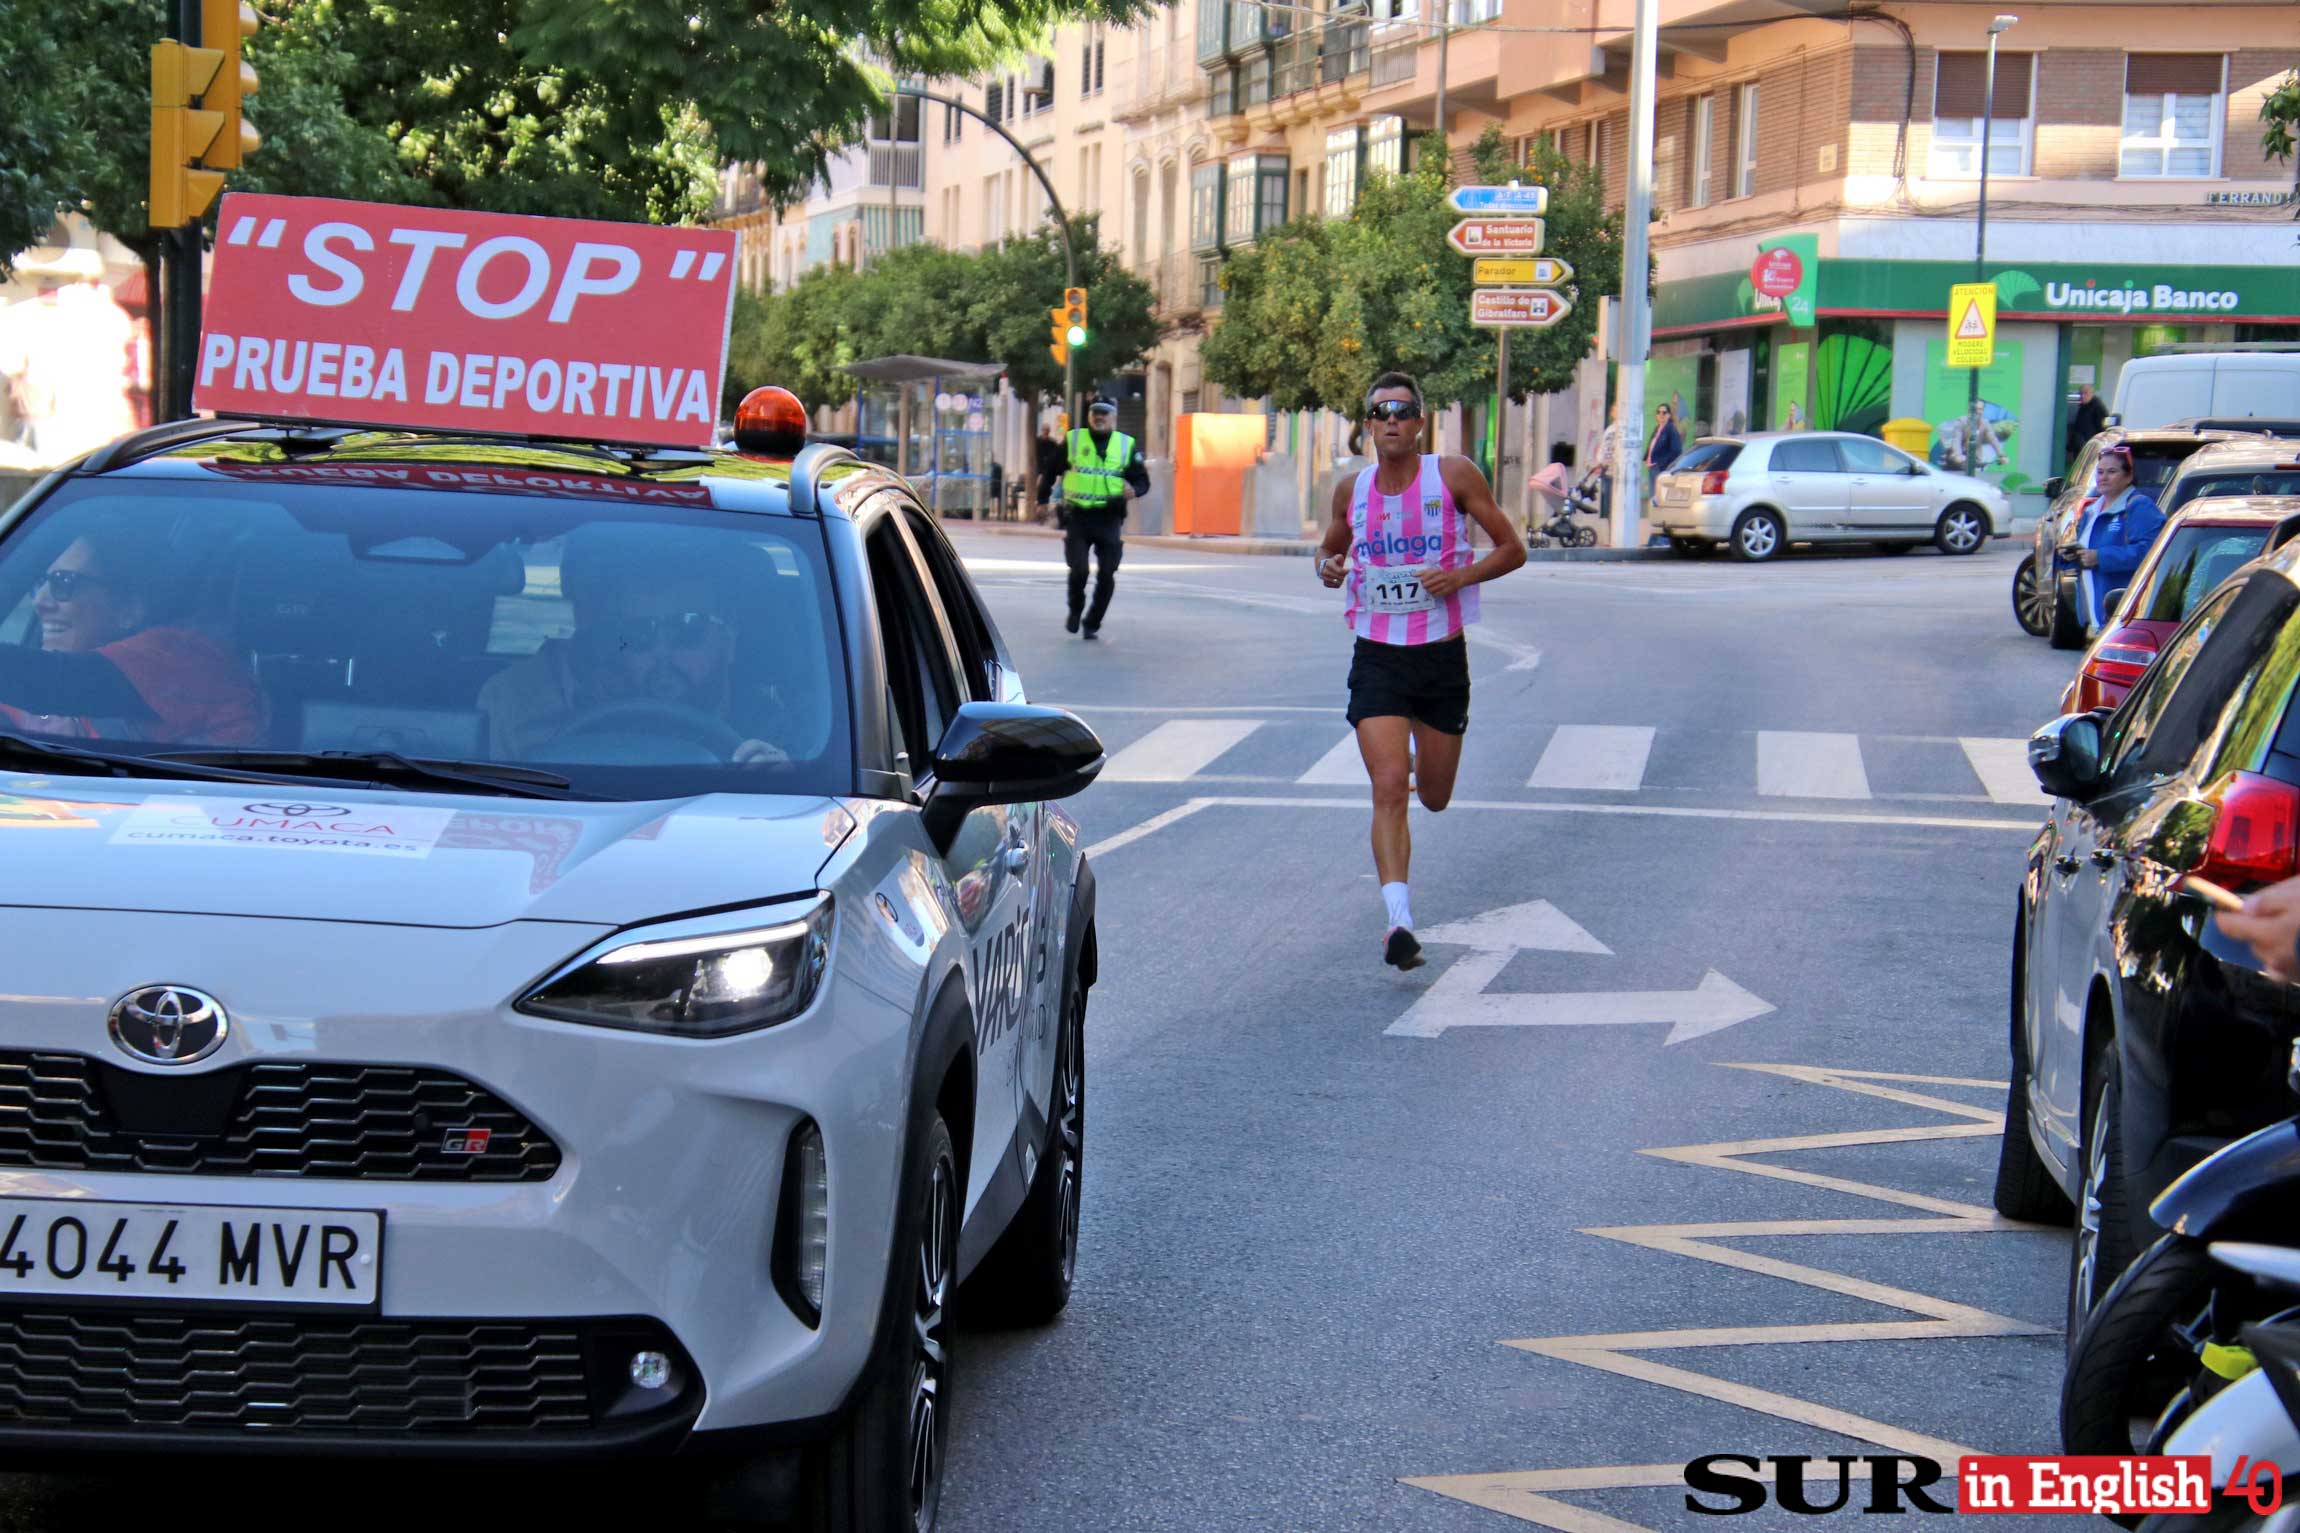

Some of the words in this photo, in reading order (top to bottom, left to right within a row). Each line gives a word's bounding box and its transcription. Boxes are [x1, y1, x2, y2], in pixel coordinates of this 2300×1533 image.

[1486, 224, 1534, 235] Santuario
[1482, 238, 1492, 247] de
[1493, 238, 1502, 247] la
[1503, 238, 1533, 247] Victoria
[1477, 266, 1517, 276] Parador
[1478, 295, 1516, 305] Castillo
[1518, 295, 1530, 305] de
[1791, 296, 1809, 315] 24
[2046, 279, 2149, 314] Unicaja
[2152, 285, 2239, 310] Banco
[1478, 309, 1528, 319] Gibralfaro
[200, 333, 408, 402] PRUEBA
[425, 350, 711, 423] DEPORTIVA
[1376, 582, 1419, 600] 117
[171, 815, 395, 836] CUMACA
[128, 830, 417, 852] cumaca.toyota.es
[444, 1138, 485, 1150] GR
[0, 1214, 187, 1283] 4044
[219, 1221, 359, 1289] MVR
